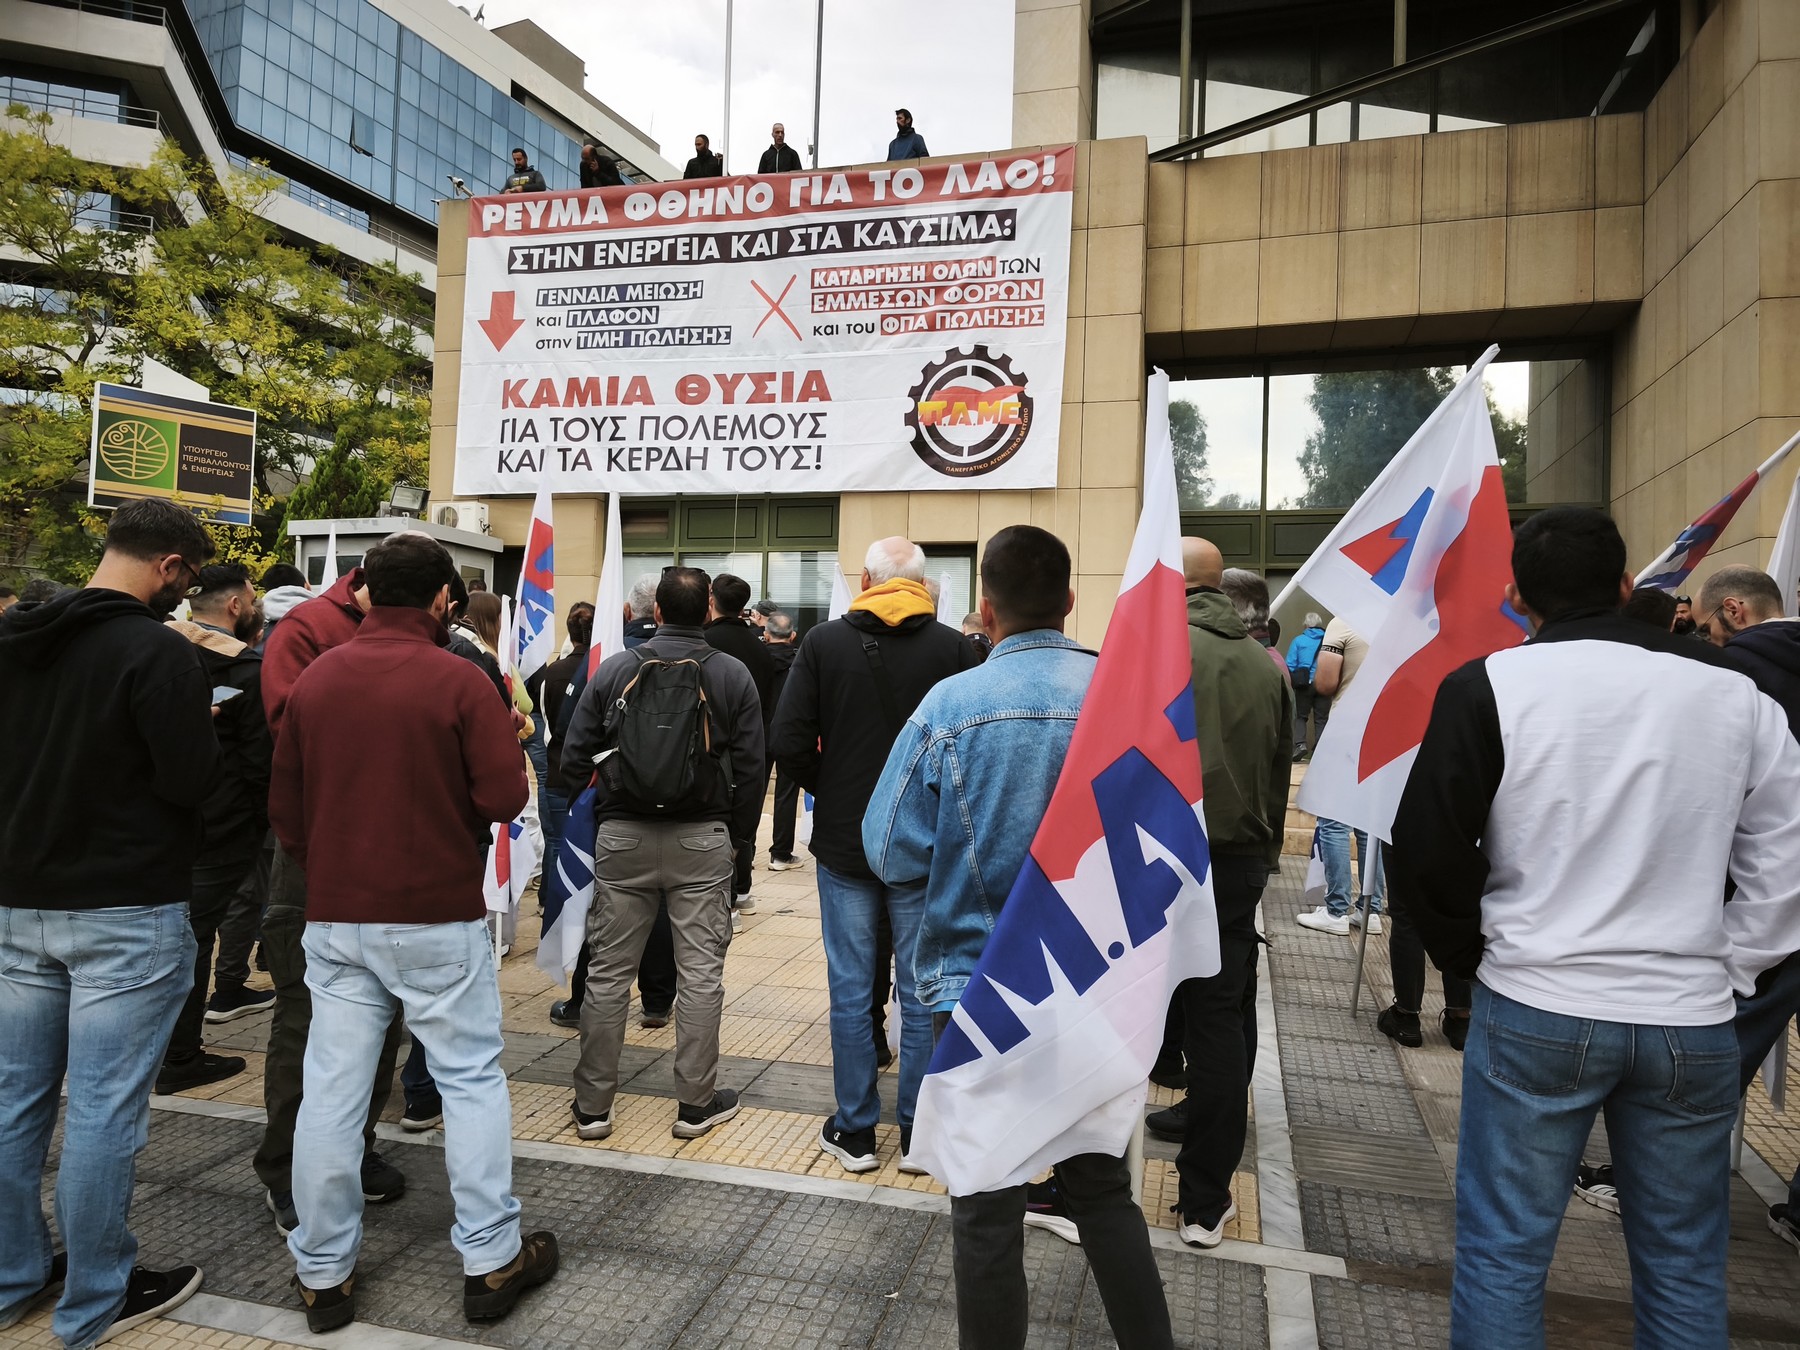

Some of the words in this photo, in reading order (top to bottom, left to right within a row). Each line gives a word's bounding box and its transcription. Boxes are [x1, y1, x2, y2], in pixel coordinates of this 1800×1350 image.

[482, 195, 609, 232] ΡΕΥΜΑ
[623, 182, 774, 222] ΦΘΗΝΟ
[790, 173, 853, 208] ΓΙΑ
[869, 167, 924, 201] ΤΟ
[940, 155, 1056, 196] ΛΑΟ!
[509, 245, 585, 270] ΣΤΗΝ
[594, 236, 721, 265] ΕΝΕΡΓΕΙΑ
[731, 231, 778, 258] ΚΑΙ
[788, 225, 843, 253] ΣΤΑ
[853, 213, 1013, 247] ΚΑΥΣΙΜΑ:
[813, 264, 926, 287] ΚΑΤΑΡΓΗΣΗ
[932, 259, 993, 280] ΟΛΩΝ
[1000, 257, 1041, 275] ΤΩΝ
[537, 285, 621, 305] ΓΕΝΝΑΙΑ
[625, 281, 703, 301] ΜΕΙΩΣΗ
[813, 288, 935, 312] ΕΜΜΕΣΩΝ
[943, 281, 1040, 303] ΦΟΡΩΝ
[536, 315, 561, 327] και
[568, 307, 657, 327] ΠΛΑΦΟΝ
[813, 323, 839, 336] και
[846, 322, 875, 334] του
[882, 312, 929, 333] ΦΠΑ
[935, 307, 1044, 329] ΠΩΛΗΣΗΣ
[535, 337, 572, 350] στην
[578, 330, 624, 348] ΤΙΜΗ
[630, 327, 731, 346] ΠΩΛΗΣΗΣ
[501, 375, 656, 409] ΚΑΜΙΑ
[675, 369, 833, 406] ΘΥΣΙΑ
[500, 418, 539, 443] ΓΙΑ
[550, 416, 627, 442] ΤΟΥΣ
[639, 412, 827, 441] ΠΟΛΕΜΟΥΣ
[182, 454, 251, 471] ΠΕΡΙΒΑΛΛΟΝΤΟΣ
[183, 445, 228, 458] ΥΠΟΥΡΓΕΙΟ
[497, 447, 545, 473] ΚΑΙ
[557, 447, 593, 472] ΤΑ
[606, 446, 708, 472] ΚΕΡΔΗ
[722, 444, 823, 471] ΤΟΥΣ!
[182, 463, 188, 471] &
[191, 465, 235, 478] ΕΝΕΡΓΕΙΑΣ
[945, 463, 989, 472] ΠΑΝΕΡΓΑΤΙΚΟ
